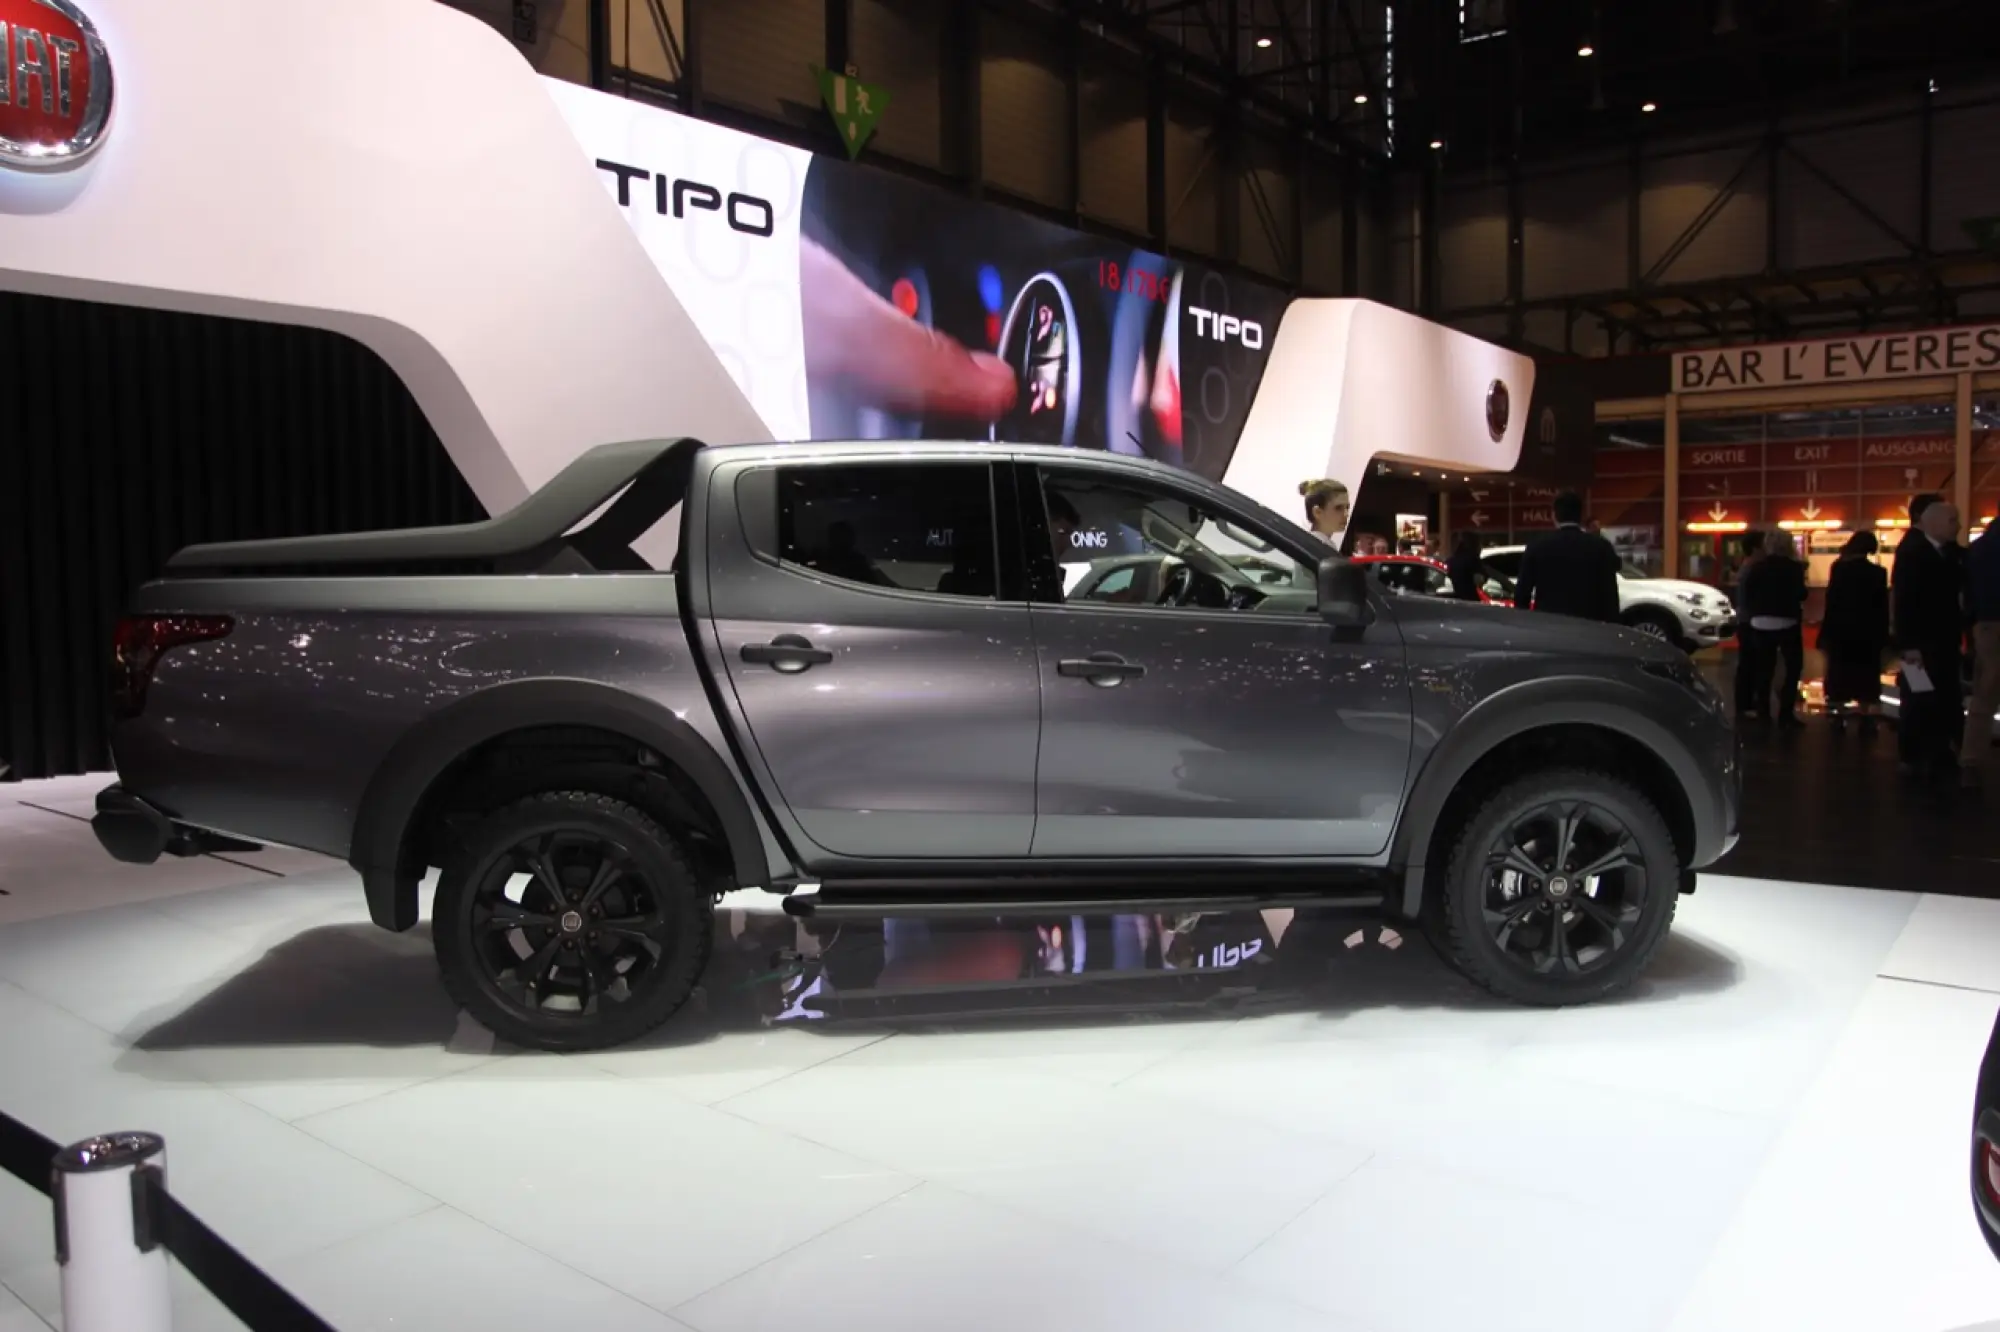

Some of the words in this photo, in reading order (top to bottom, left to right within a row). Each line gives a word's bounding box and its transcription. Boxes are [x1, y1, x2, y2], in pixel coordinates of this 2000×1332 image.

[595, 158, 773, 237] TIPO
[1188, 305, 1263, 349] TIPO
[1682, 350, 1765, 388] BAR
[1691, 450, 1746, 465] SORTIE
[1794, 445, 1831, 460] EXIT
